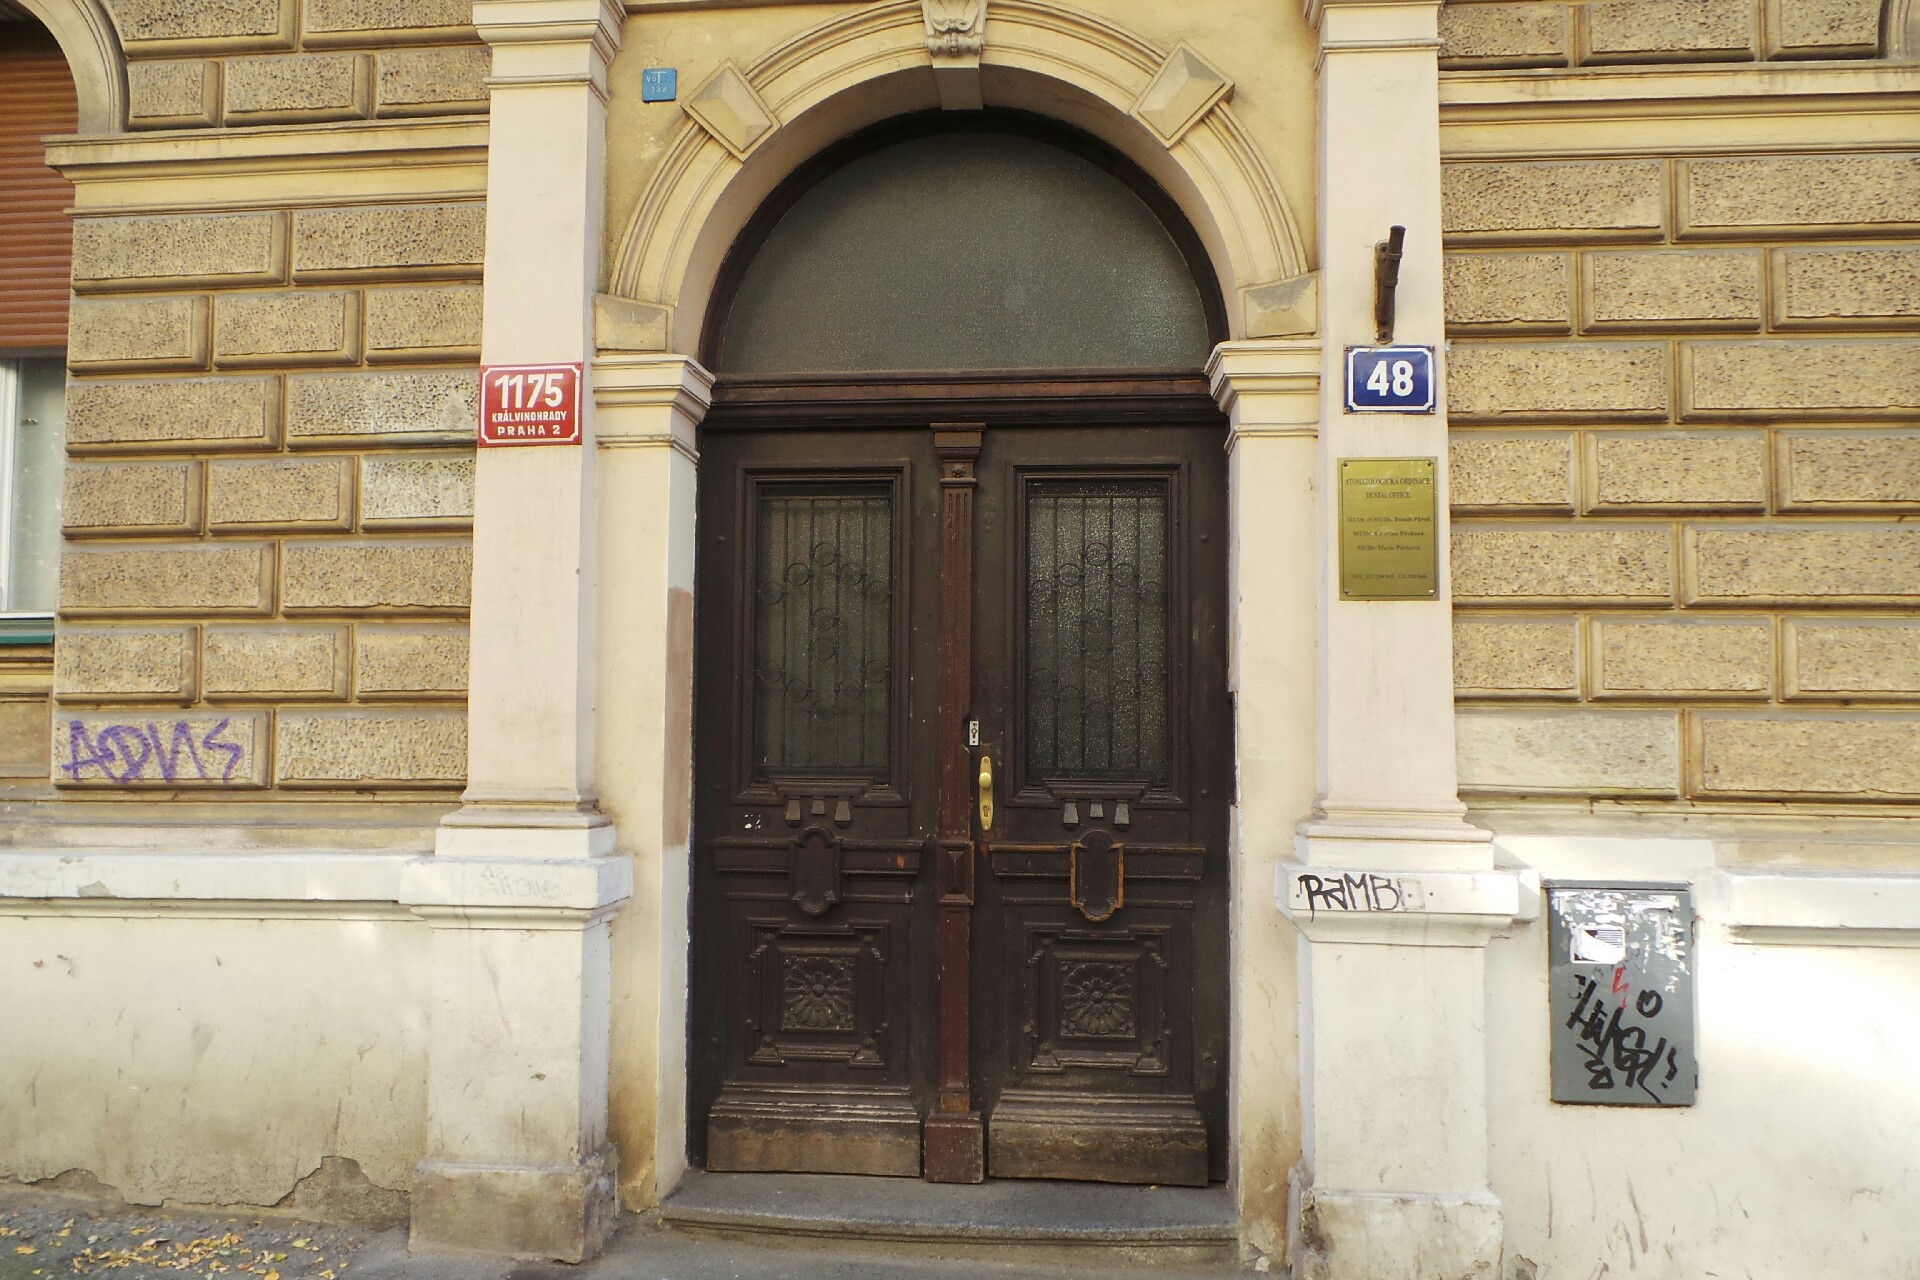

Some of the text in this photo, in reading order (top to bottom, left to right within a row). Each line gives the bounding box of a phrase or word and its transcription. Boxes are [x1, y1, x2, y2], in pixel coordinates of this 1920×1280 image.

[1367, 360, 1414, 397] 48
[494, 373, 564, 409] 1175
[497, 424, 561, 436] PRAHA 2
[1399, 477, 1431, 485] ORDINACE
[1366, 491, 1411, 499] DENTAL OFFICE
